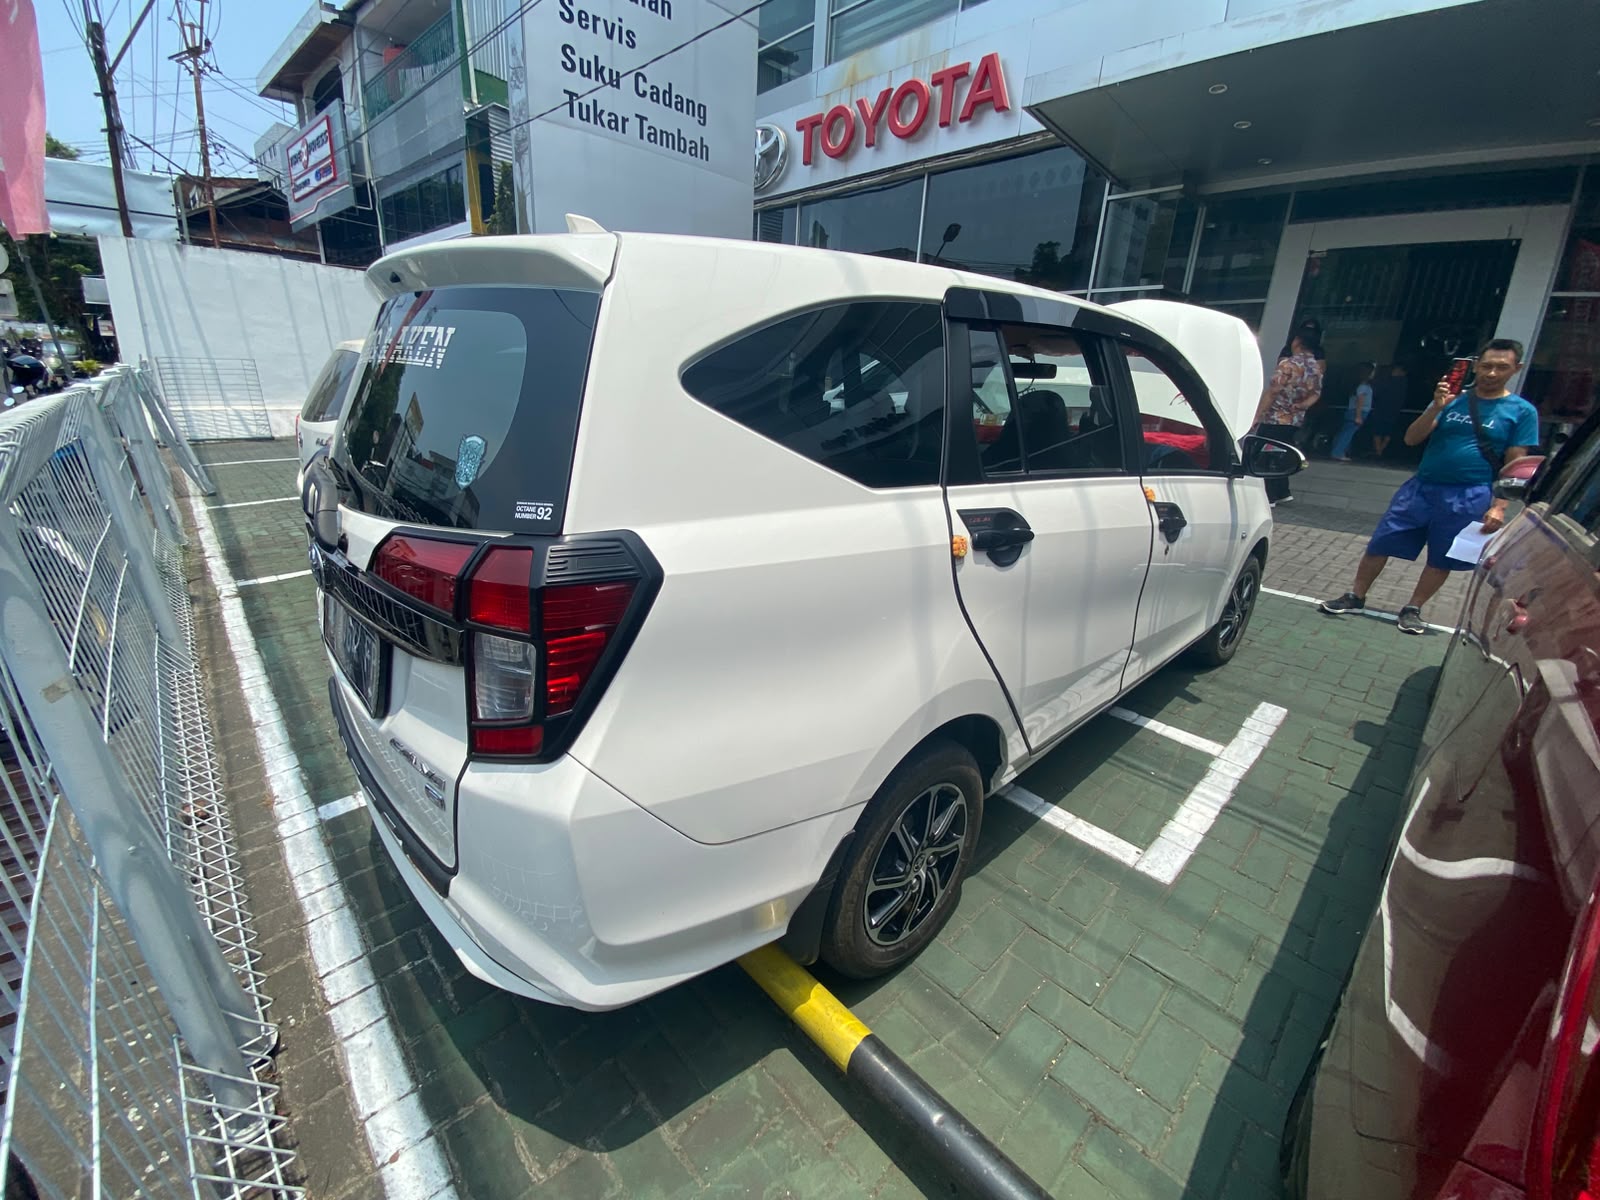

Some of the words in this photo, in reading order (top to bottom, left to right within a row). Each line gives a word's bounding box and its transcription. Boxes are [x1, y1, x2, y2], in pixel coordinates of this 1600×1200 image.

[559, 0, 637, 49] Servis
[561, 43, 621, 90] Suku
[634, 71, 708, 127] Cadang
[796, 52, 1011, 166] TOYOTA
[563, 89, 630, 135] Tukar
[634, 113, 710, 162] Tambah
[514, 512, 537, 520] NUMBER
[536, 506, 553, 520] 92
